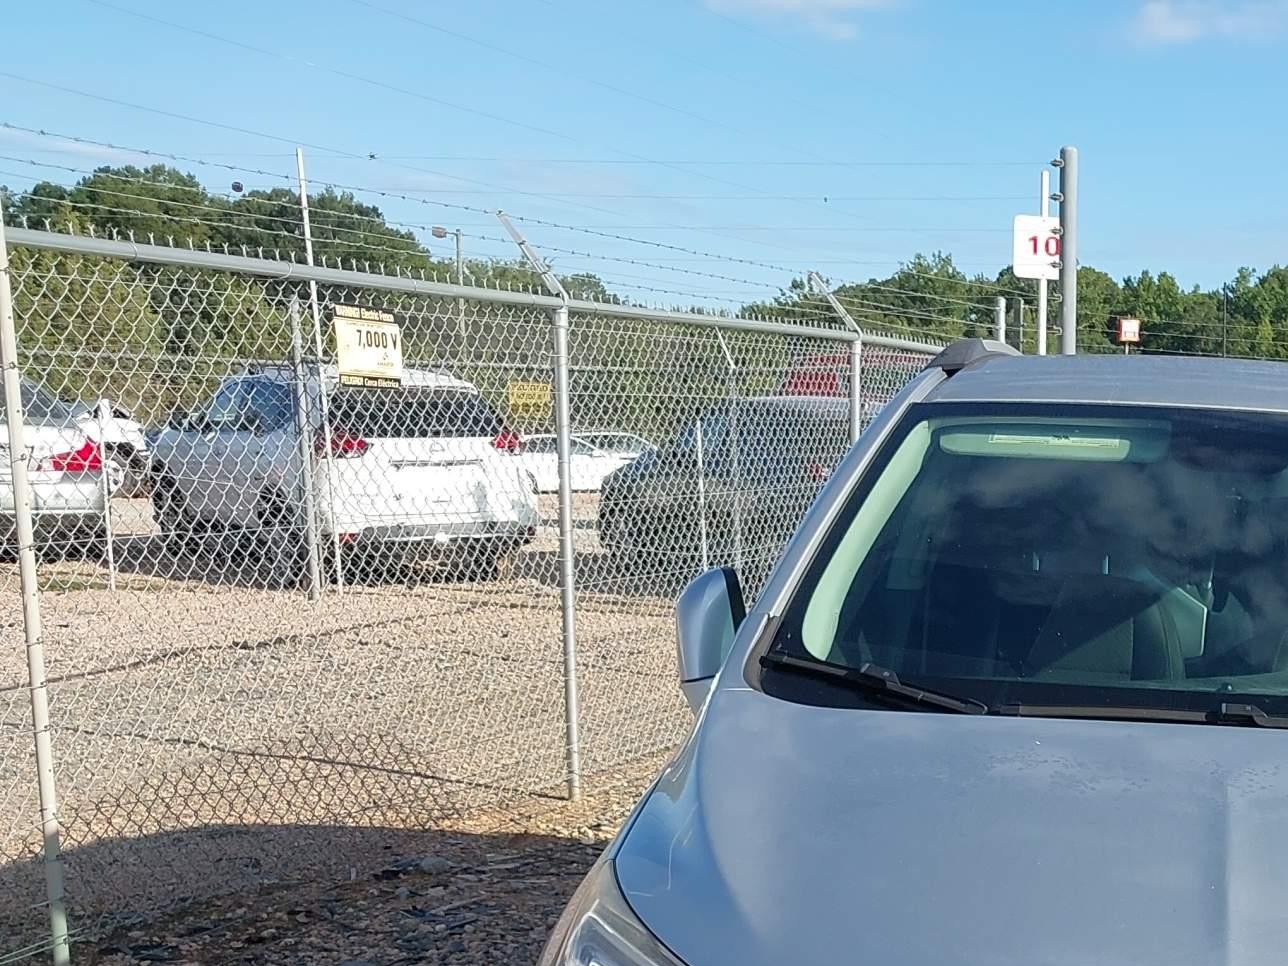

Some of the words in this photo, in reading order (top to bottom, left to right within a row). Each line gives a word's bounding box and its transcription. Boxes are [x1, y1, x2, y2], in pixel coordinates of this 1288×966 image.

[1028, 235, 1060, 256] 10
[361, 307, 379, 321] Electric
[357, 329, 388, 349] 7,000
[391, 333, 397, 350] V
